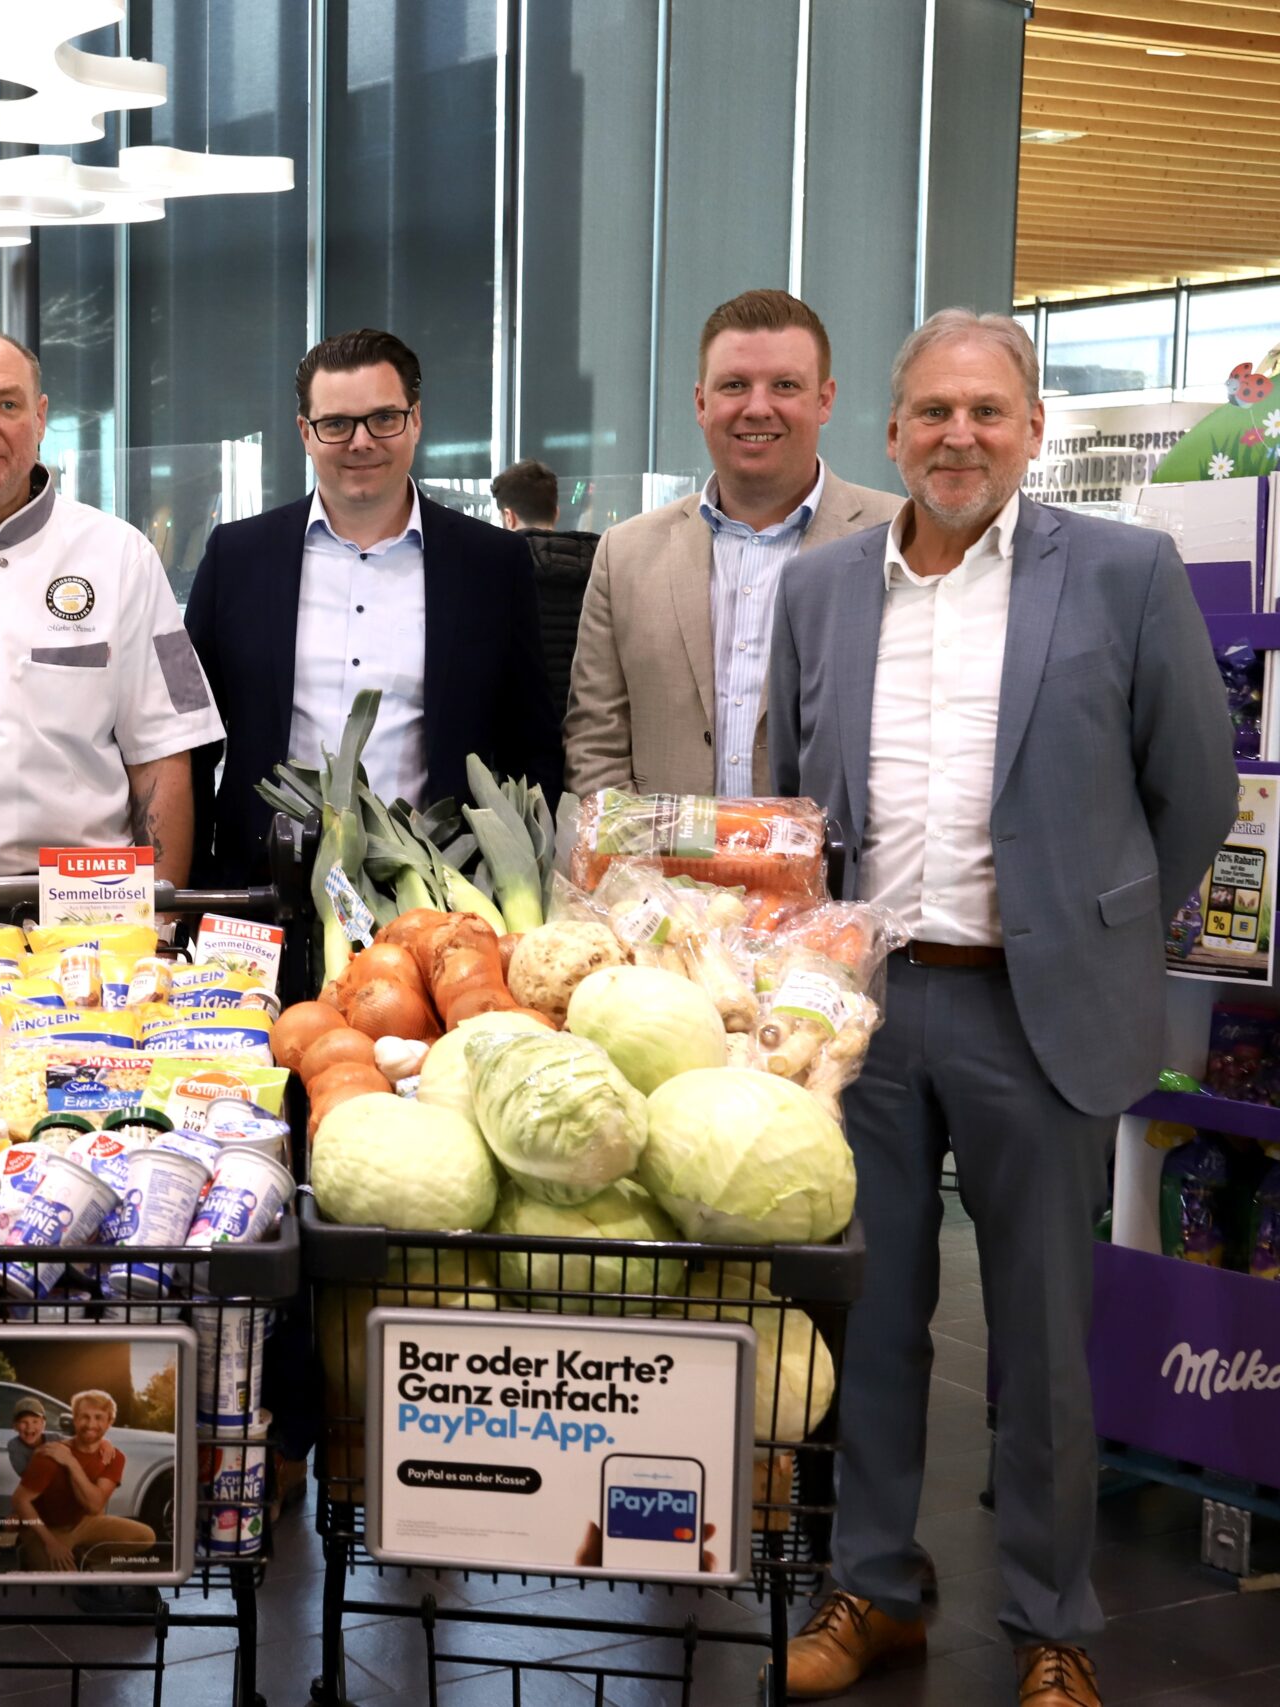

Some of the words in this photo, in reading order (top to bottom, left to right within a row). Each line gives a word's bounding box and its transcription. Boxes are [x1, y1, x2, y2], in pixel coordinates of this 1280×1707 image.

[1047, 430, 1126, 455] FILTERTÜTEN
[1081, 488, 1122, 502] KEKSE
[51, 607, 90, 620] DEUTSCHLAND
[67, 859, 127, 871] LEIMER
[1218, 853, 1233, 863] 20%
[48, 887, 146, 900] Semmelbrösel
[214, 920, 272, 941] LEIMER
[204, 940, 276, 960] Semmelbrösel
[141, 1011, 216, 1033] HENEIN
[398, 1341, 460, 1372] Bar
[466, 1346, 549, 1378] oder
[556, 1349, 675, 1384] Karte?
[398, 1372, 493, 1406] Ganz
[500, 1379, 640, 1415] einfach:
[398, 1403, 616, 1453] PayPal-App.
[220, 1473, 257, 1486] SCHAG-
[407, 1467, 444, 1481] PayPal
[445, 1473, 458, 1481] es
[459, 1473, 473, 1481] an
[475, 1472, 494, 1483] der
[213, 1481, 261, 1501] SAHNE
[609, 1489, 695, 1517] PayPal
[22, 1517, 45, 1526] work.
[110, 1555, 160, 1565] join.asap.de
